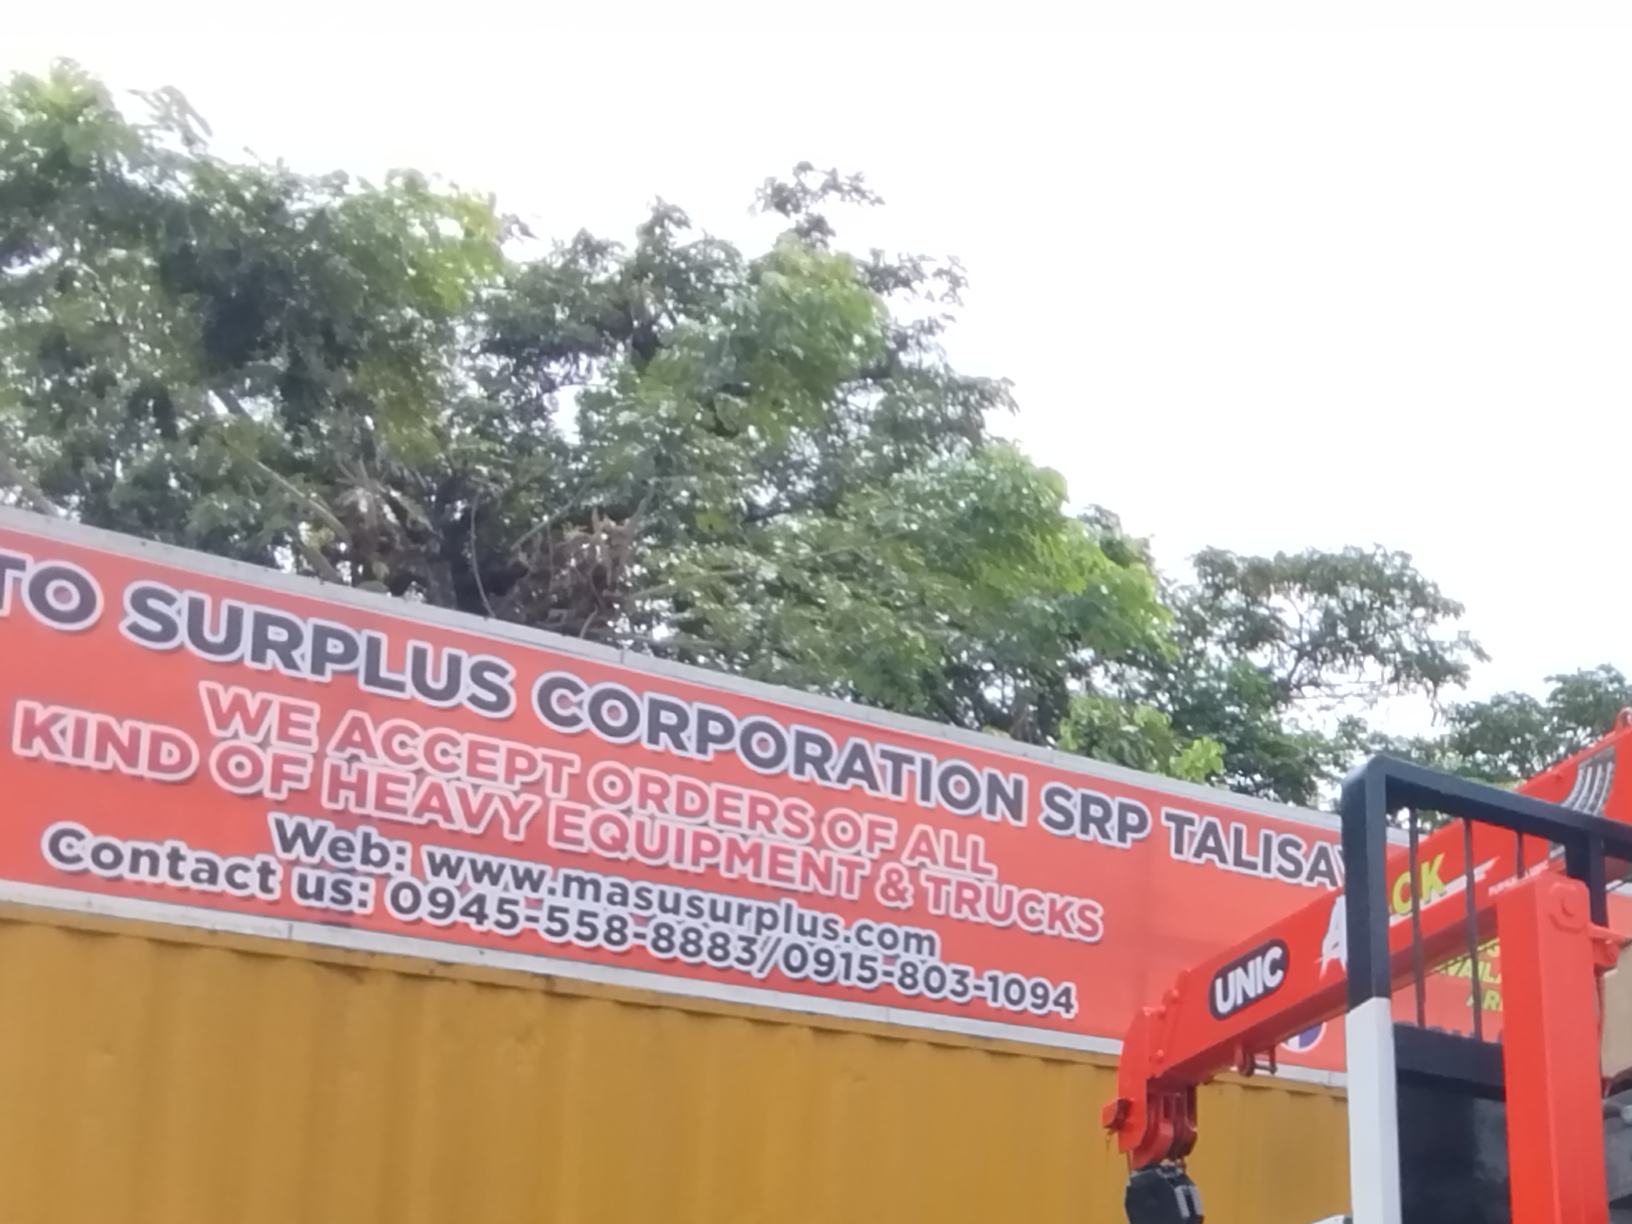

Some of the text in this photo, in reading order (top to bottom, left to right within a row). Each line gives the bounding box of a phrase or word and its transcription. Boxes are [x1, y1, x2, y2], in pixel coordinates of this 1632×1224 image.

[14, 701, 1103, 941] KIND OF HEAVY EQUIPMENT & TRUCKS
[124, 584, 512, 714] SURPLUS
[535, 675, 1025, 823] CORPORATION
[1042, 785, 1150, 844] SRP
[1163, 812, 1344, 887] TALISA
[202, 684, 994, 878] WE ACCEPT ORDERS OF ALL
[46, 826, 1076, 1015] Contact us: 0945-558-8883/0915-803-1094
[273, 816, 937, 957] Web: www.masusurplus.com
[1214, 946, 1284, 1014] UNIC
